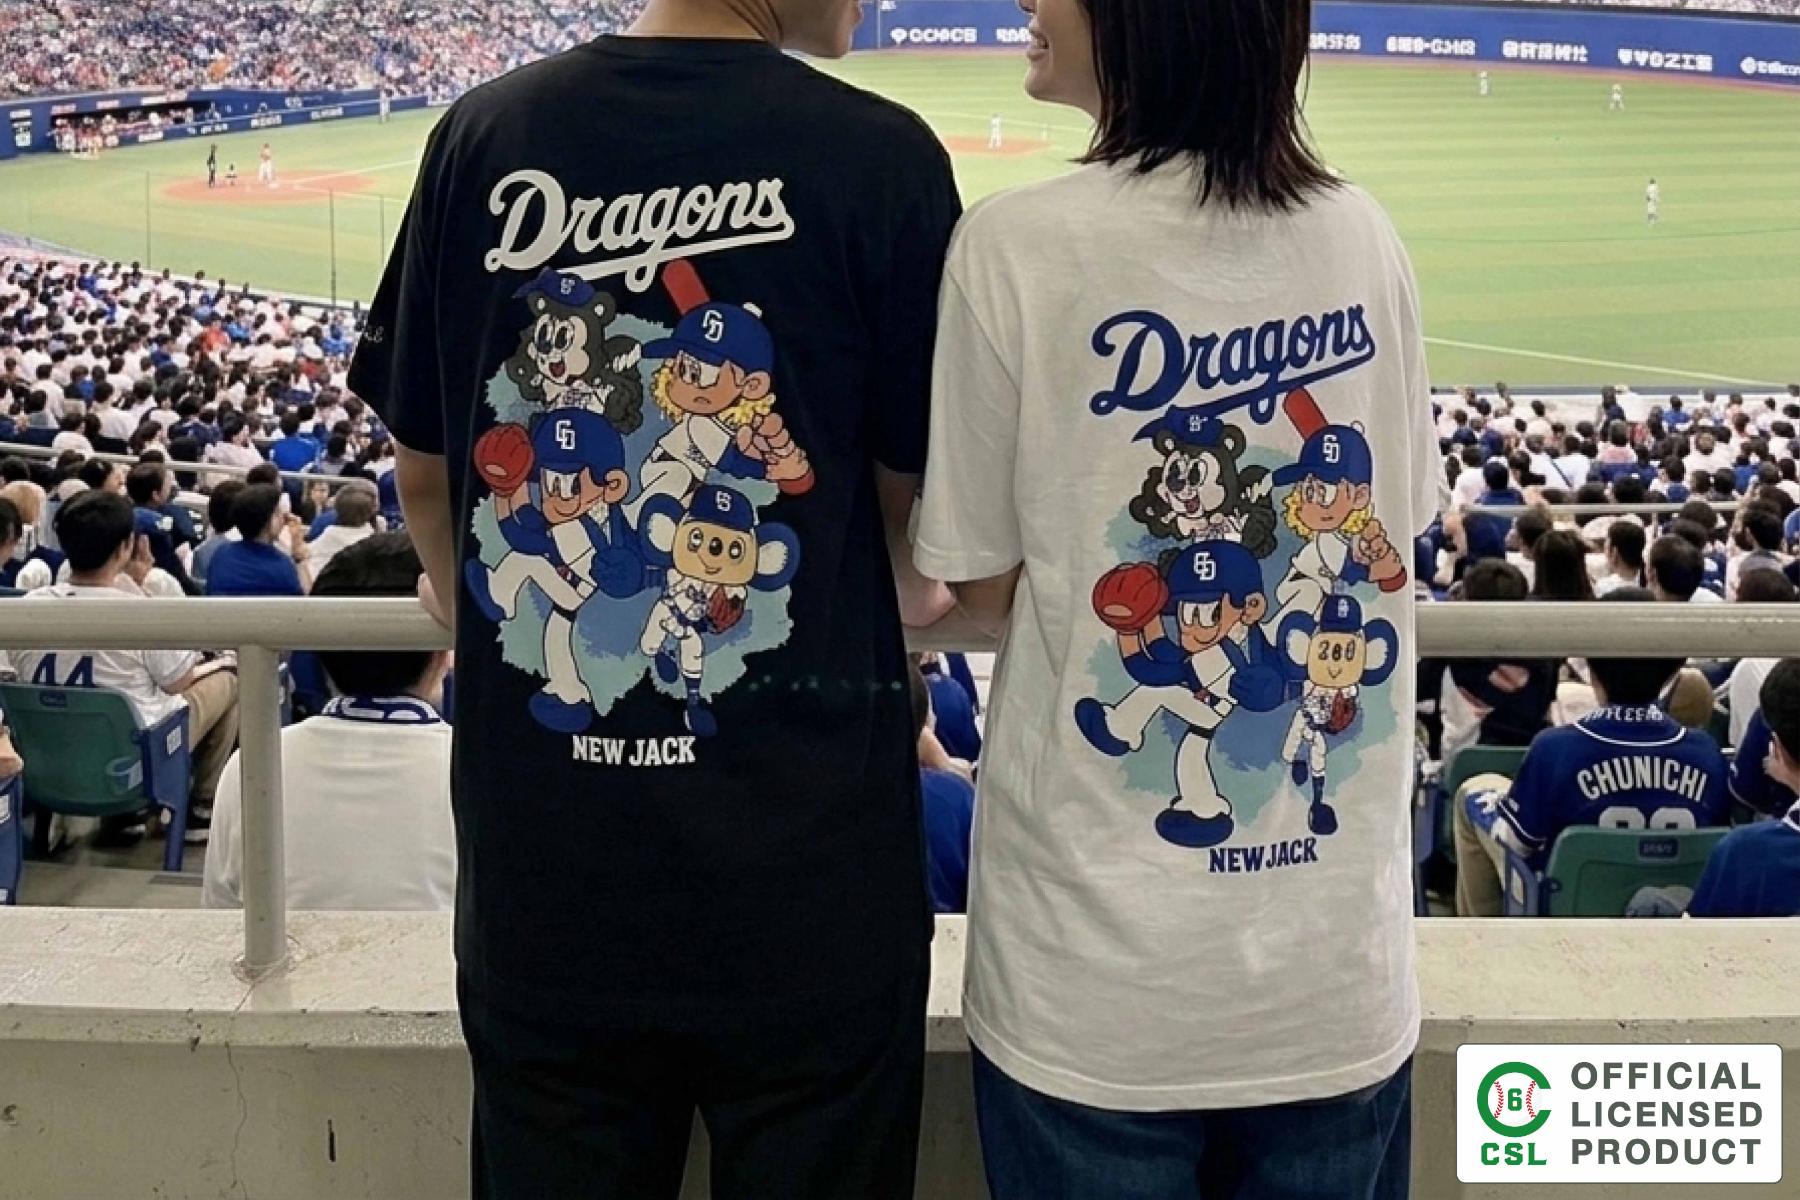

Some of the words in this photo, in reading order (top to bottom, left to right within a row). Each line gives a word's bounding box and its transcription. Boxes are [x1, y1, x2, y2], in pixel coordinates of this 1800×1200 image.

[484, 169, 796, 293] Dragons
[1089, 304, 1376, 425] Dragons
[572, 734, 626, 765] NEW
[628, 735, 696, 767] JACK
[1577, 755, 1708, 802] CHUNICHI
[1209, 846, 1265, 874] NEW
